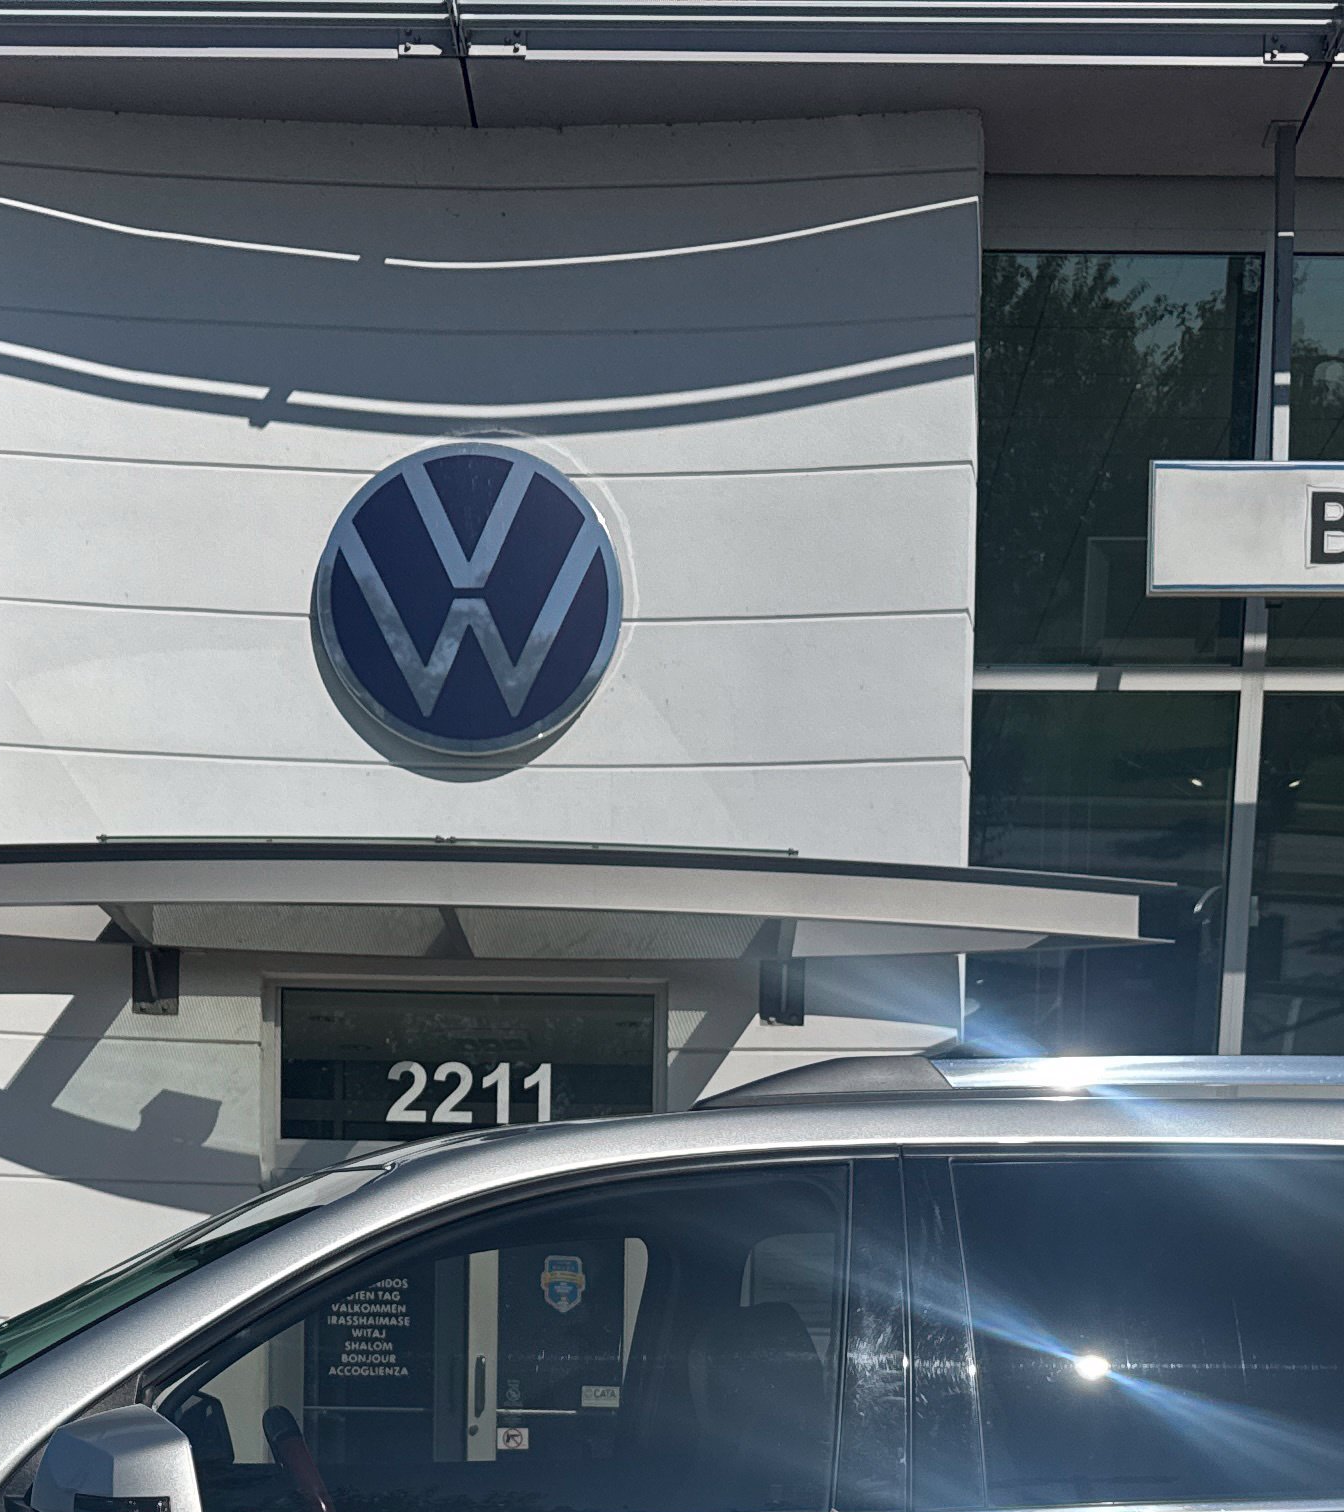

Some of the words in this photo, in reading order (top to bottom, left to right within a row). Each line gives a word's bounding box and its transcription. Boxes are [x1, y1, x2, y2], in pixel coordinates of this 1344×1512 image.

[385, 1060, 552, 1124] 2211
[377, 1291, 401, 1301] TAG
[351, 1328, 386, 1338] WITAJ
[344, 1341, 393, 1351] SHALOM
[340, 1353, 397, 1363] BONJOUR
[328, 1365, 409, 1376] ACCOGLIENZA
